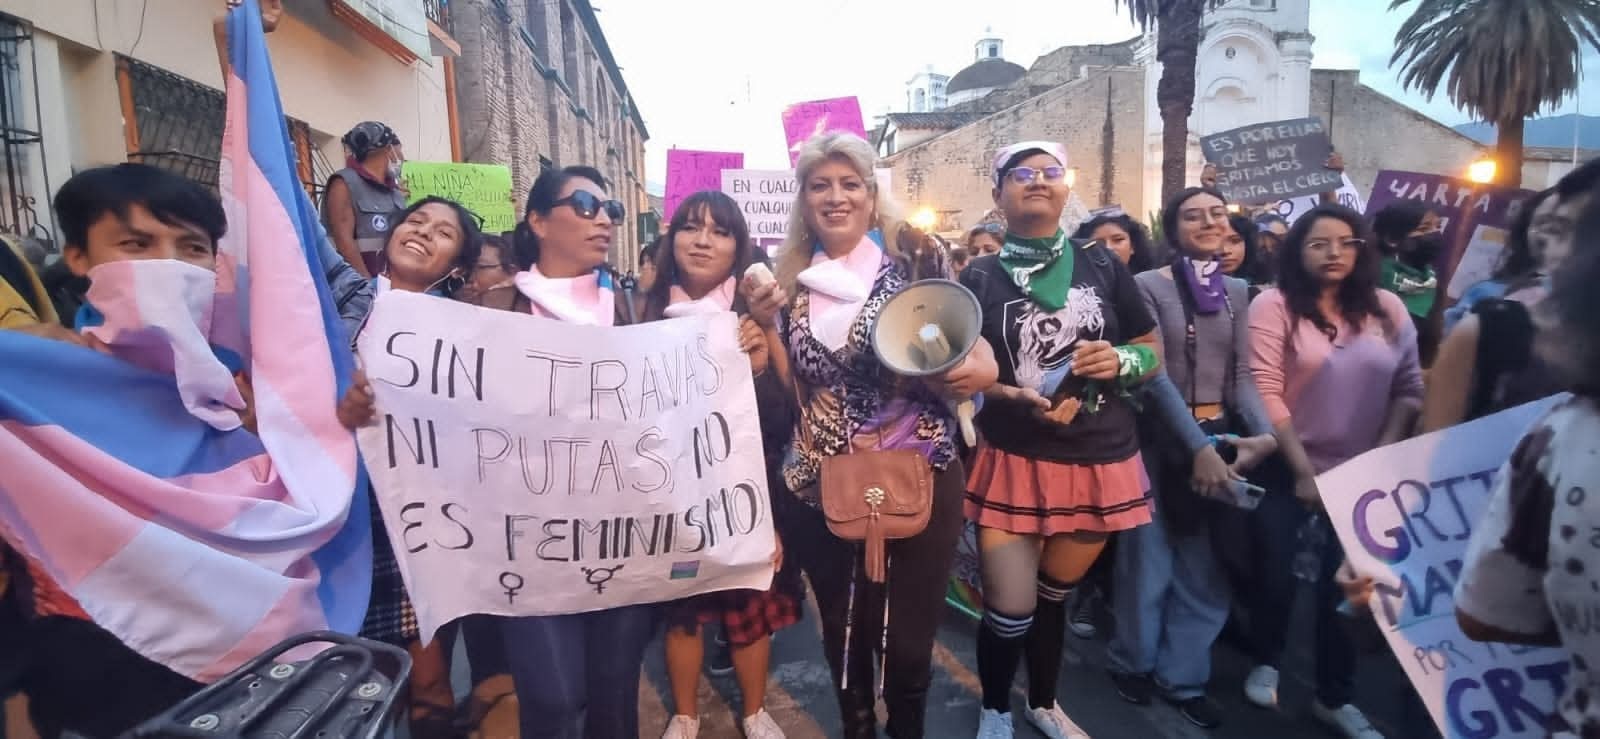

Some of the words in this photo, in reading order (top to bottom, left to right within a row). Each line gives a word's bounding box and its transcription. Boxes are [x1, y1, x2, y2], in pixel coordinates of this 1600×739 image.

[1208, 136, 1234, 152] ES
[1239, 127, 1275, 145] POR
[1276, 122, 1323, 139] ELLAS
[1222, 148, 1257, 168] QUE
[1266, 143, 1296, 160] HOY
[733, 179, 751, 193] EN
[1216, 160, 1303, 186] GRITAMOS
[1271, 180, 1295, 194] EL
[1295, 171, 1340, 188] CIELO
[376, 331, 485, 401] SIN
[525, 334, 723, 422] TRAVAS
[385, 413, 438, 469] NI
[693, 410, 731, 479] NO
[399, 501, 474, 554] ES
[504, 478, 765, 563] FEMINISMO
[1413, 639, 1473, 675] POR
